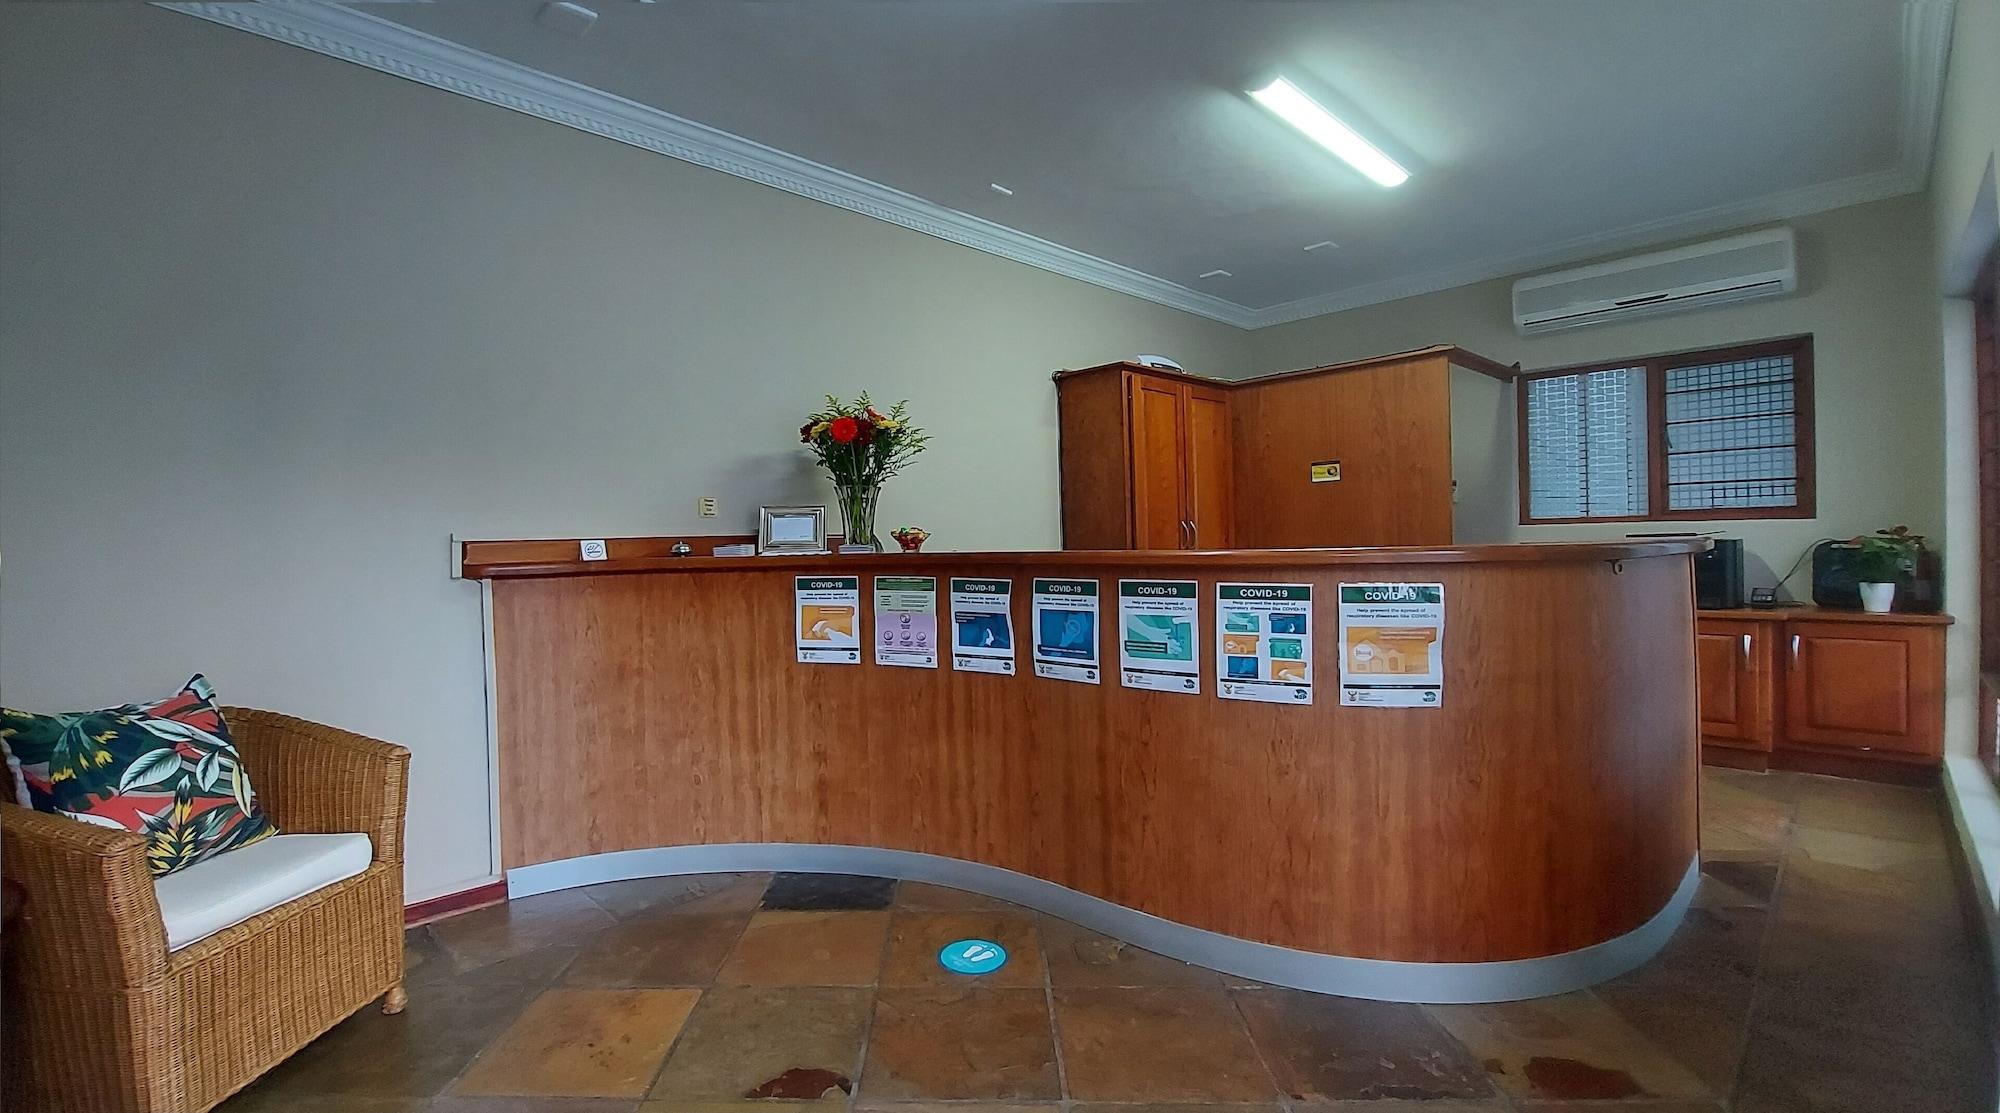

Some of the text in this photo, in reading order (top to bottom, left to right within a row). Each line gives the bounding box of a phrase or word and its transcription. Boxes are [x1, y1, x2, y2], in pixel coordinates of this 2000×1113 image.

[965, 584, 996, 592] COVID-19
[1048, 584, 1082, 593] COVID-19
[1137, 586, 1178, 595] COVID-19
[1240, 588, 1288, 598] COVID-19
[1364, 591, 1417, 600] COVID-19
